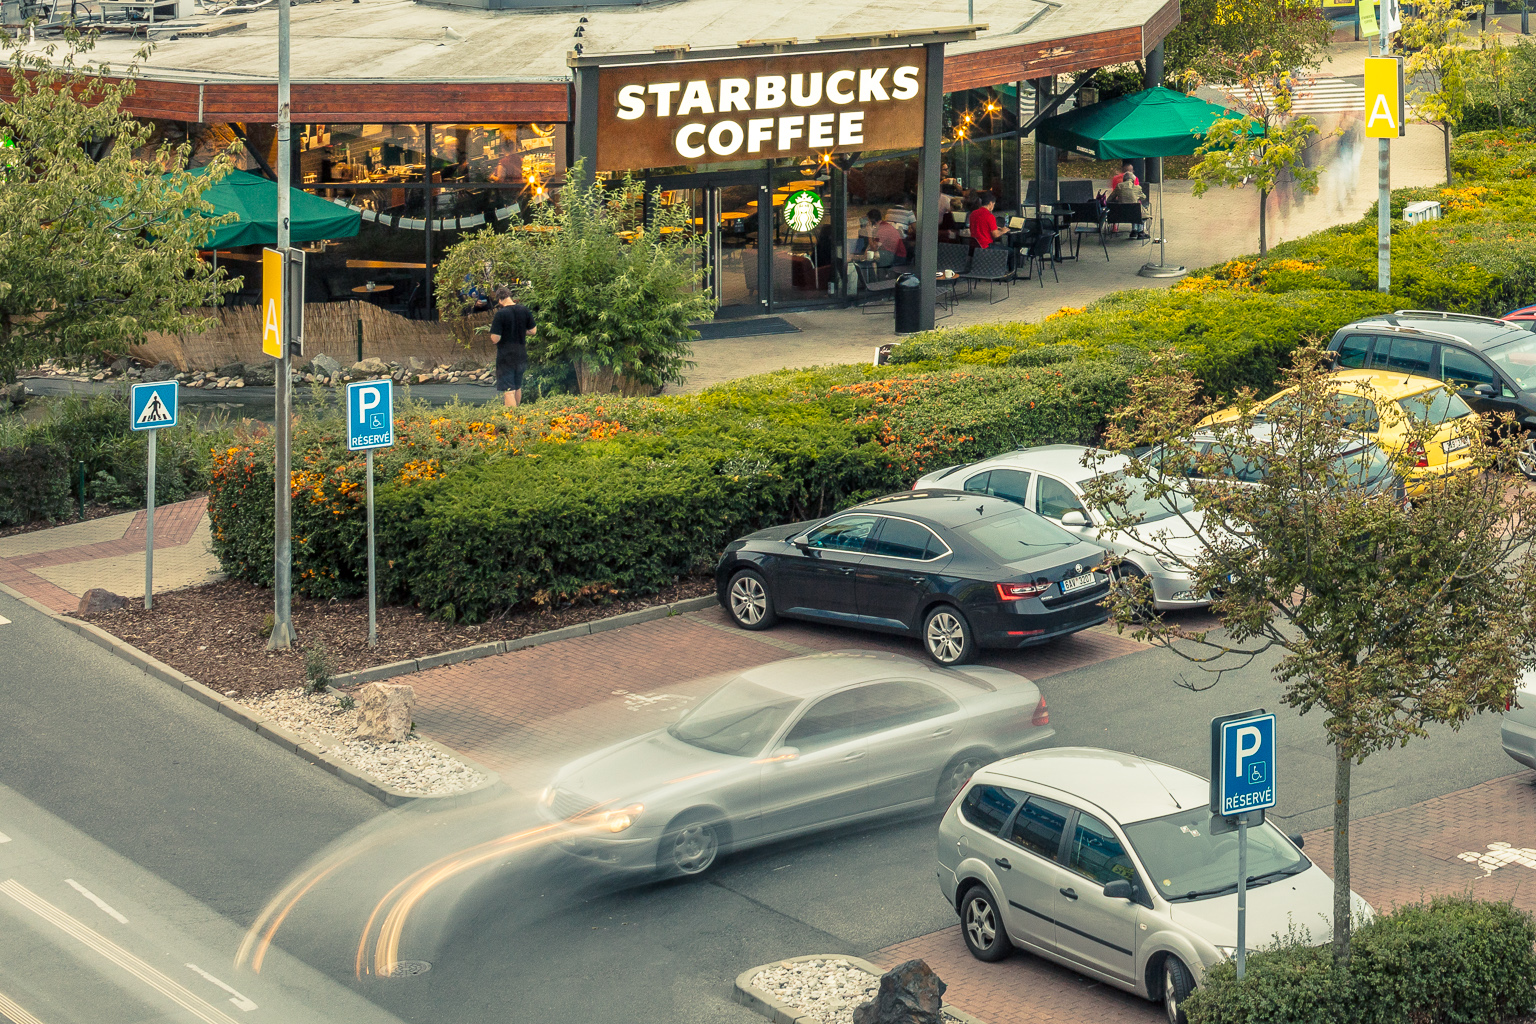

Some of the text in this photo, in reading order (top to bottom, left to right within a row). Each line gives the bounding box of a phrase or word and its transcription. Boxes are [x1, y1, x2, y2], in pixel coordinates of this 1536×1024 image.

[616, 65, 920, 121] STARBUCKS
[1368, 94, 1395, 129] A
[675, 110, 865, 159] COFFEE
[263, 298, 281, 345] A
[359, 387, 381, 424] P
[351, 430, 390, 447] RÉSERVÉ
[1235, 725, 1262, 778] P
[1225, 785, 1272, 810] RÉSERVÉ
